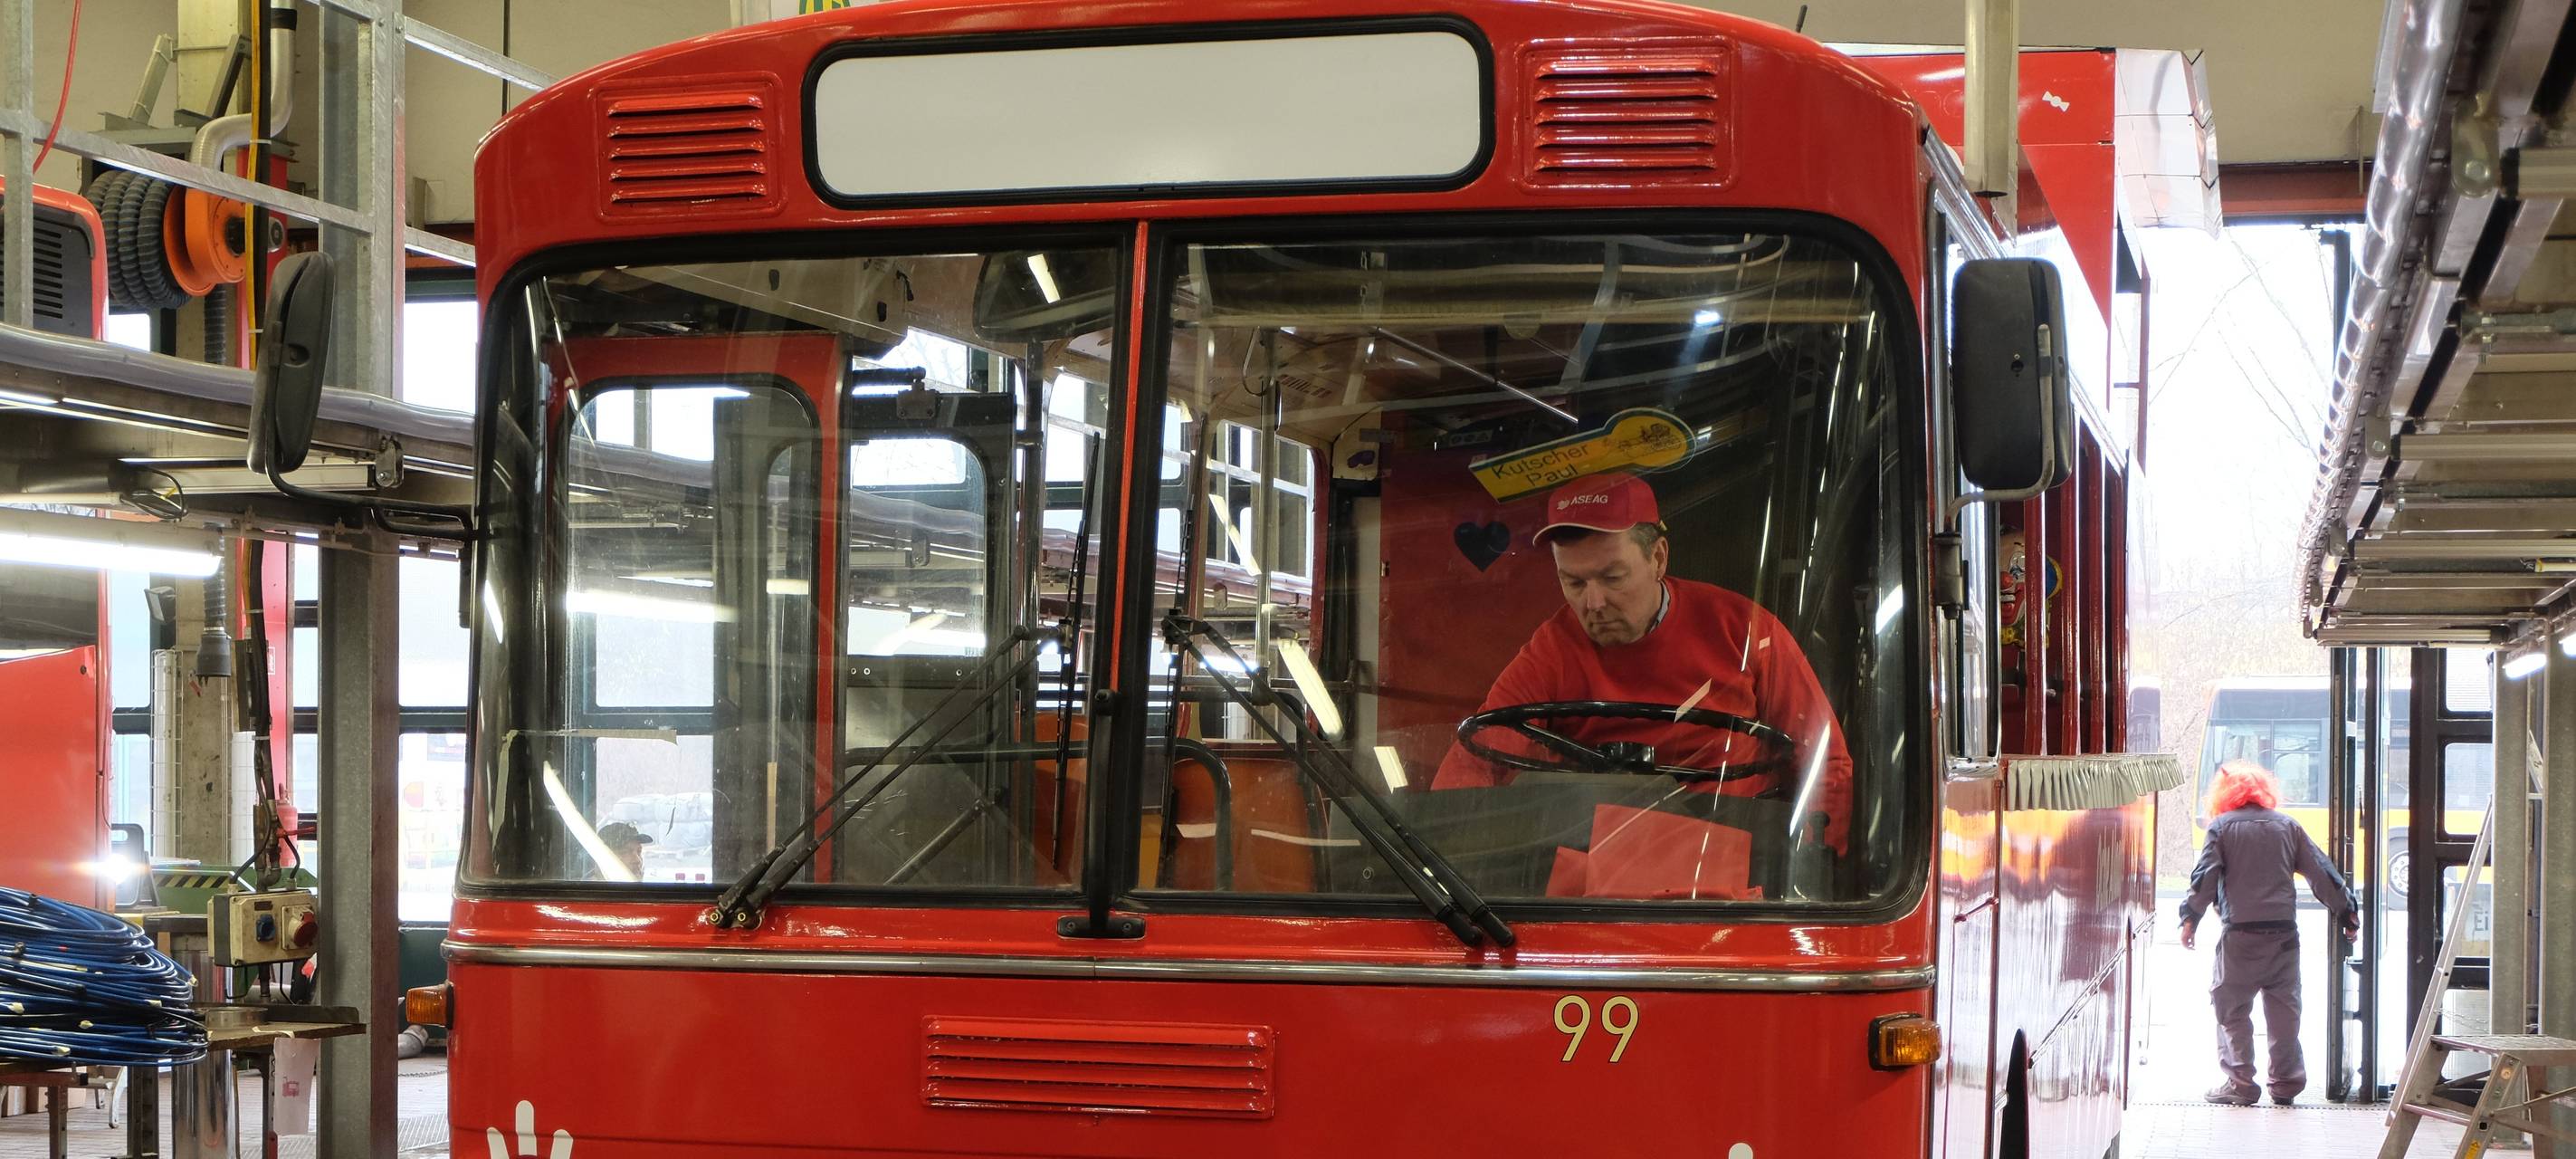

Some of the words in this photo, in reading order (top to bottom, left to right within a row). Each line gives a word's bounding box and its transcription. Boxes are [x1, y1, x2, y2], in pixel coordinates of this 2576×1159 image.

[1492, 444, 1589, 479] Kutscher
[1526, 463, 1579, 487] Paul
[1570, 493, 1608, 505] ASEAG
[1553, 994, 1640, 1063] 99
